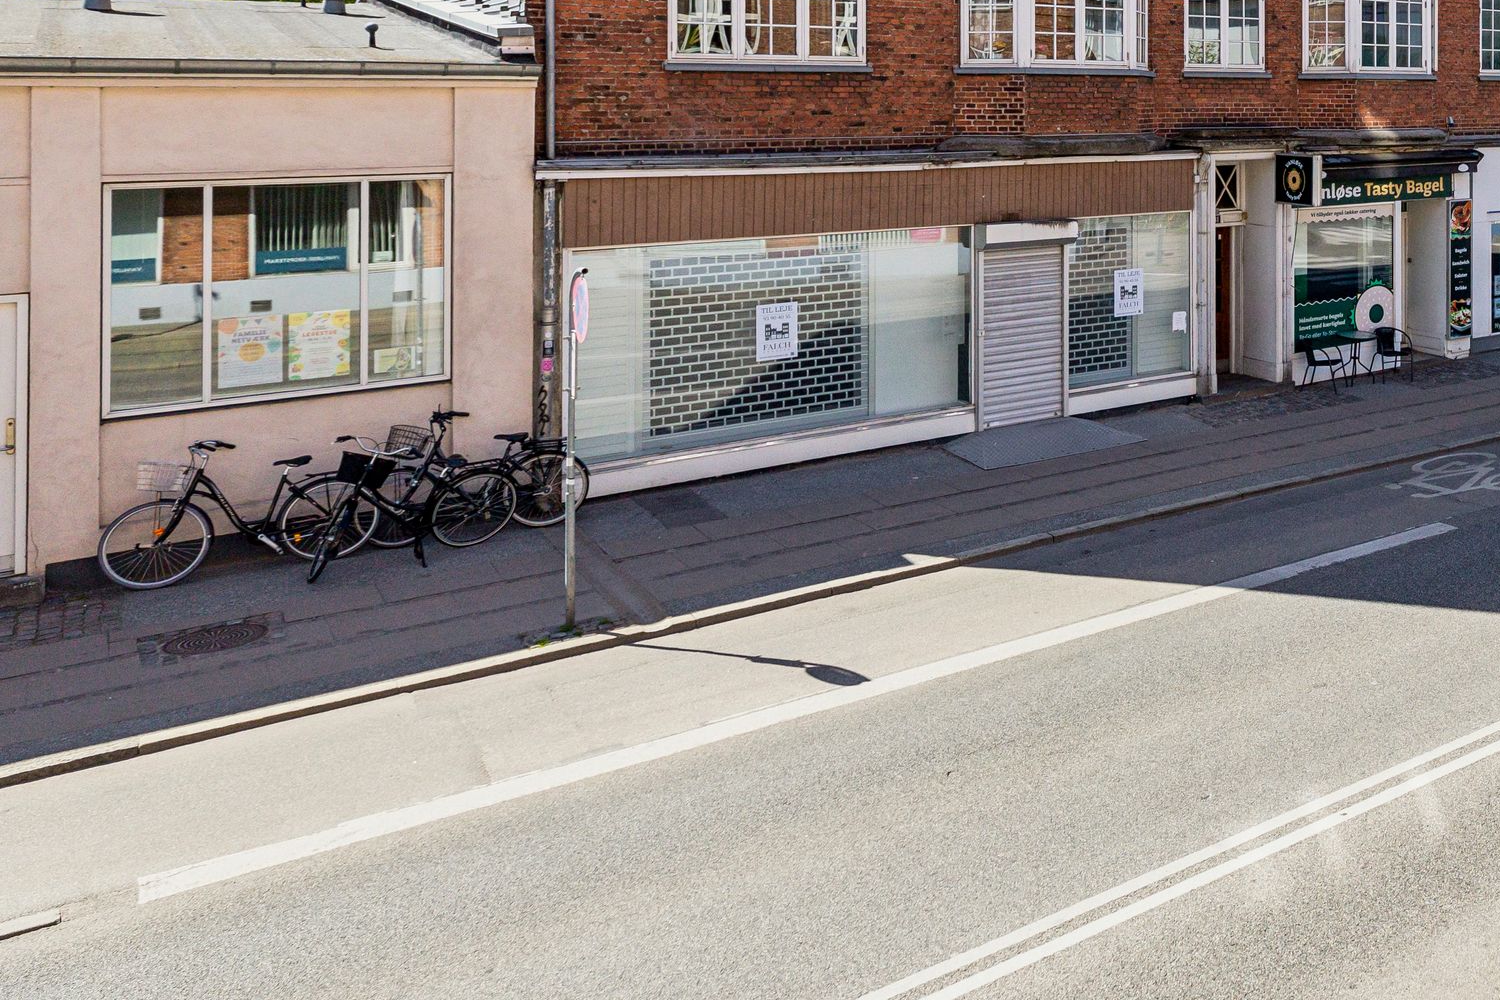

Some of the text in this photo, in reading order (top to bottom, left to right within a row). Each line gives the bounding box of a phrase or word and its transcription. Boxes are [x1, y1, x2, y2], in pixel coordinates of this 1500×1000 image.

[1322, 177, 1444, 200] nløse Tasty Bagel
